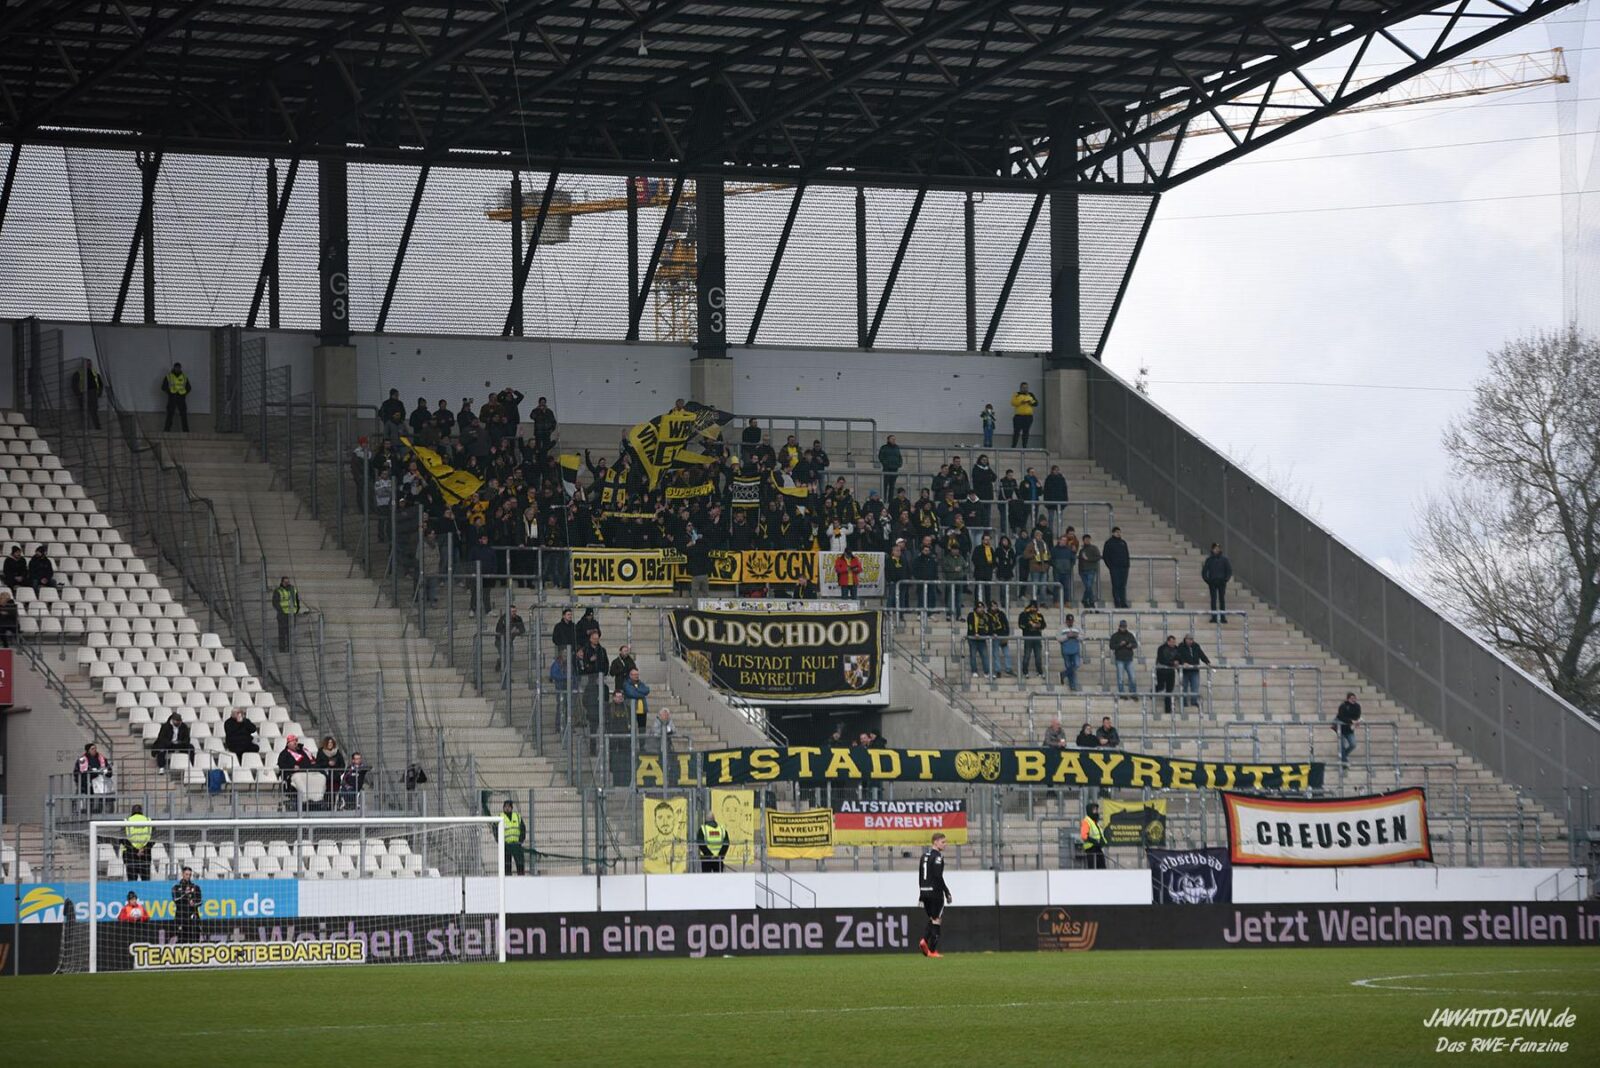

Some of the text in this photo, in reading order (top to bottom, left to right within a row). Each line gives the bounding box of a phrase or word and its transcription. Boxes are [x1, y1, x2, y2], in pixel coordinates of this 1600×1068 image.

[329, 272, 348, 295] G
[707, 286, 726, 309] G
[331, 298, 346, 321] 3
[709, 311, 723, 333] 3
[573, 558, 615, 582] SZENE
[640, 558, 672, 582] 1921
[774, 551, 817, 581] CGN
[682, 615, 871, 648] OLDSCHDOD
[718, 653, 839, 671] ALTSTADT KULT
[740, 671, 816, 686] BAYREUTH
[636, 746, 941, 786] ALTSTADT
[1014, 750, 1311, 791] BAYREUTH
[840, 799, 962, 814] ALTSTADTFRONT
[779, 825, 825, 834] BAYREUTH
[864, 813, 943, 828] BAYREUTH
[1256, 814, 1408, 848] CREUSSEN
[426, 917, 547, 956] stellen
[560, 917, 590, 953] in
[603, 916, 675, 952] eine
[687, 914, 823, 958] goldene
[835, 912, 909, 948] Zeit!
[1223, 910, 1309, 944] Jetzt
[1319, 908, 1453, 941] Weichen
[1462, 906, 1568, 940] stellen
[132, 940, 363, 967] TEAMSPORTBEDARF.DE
